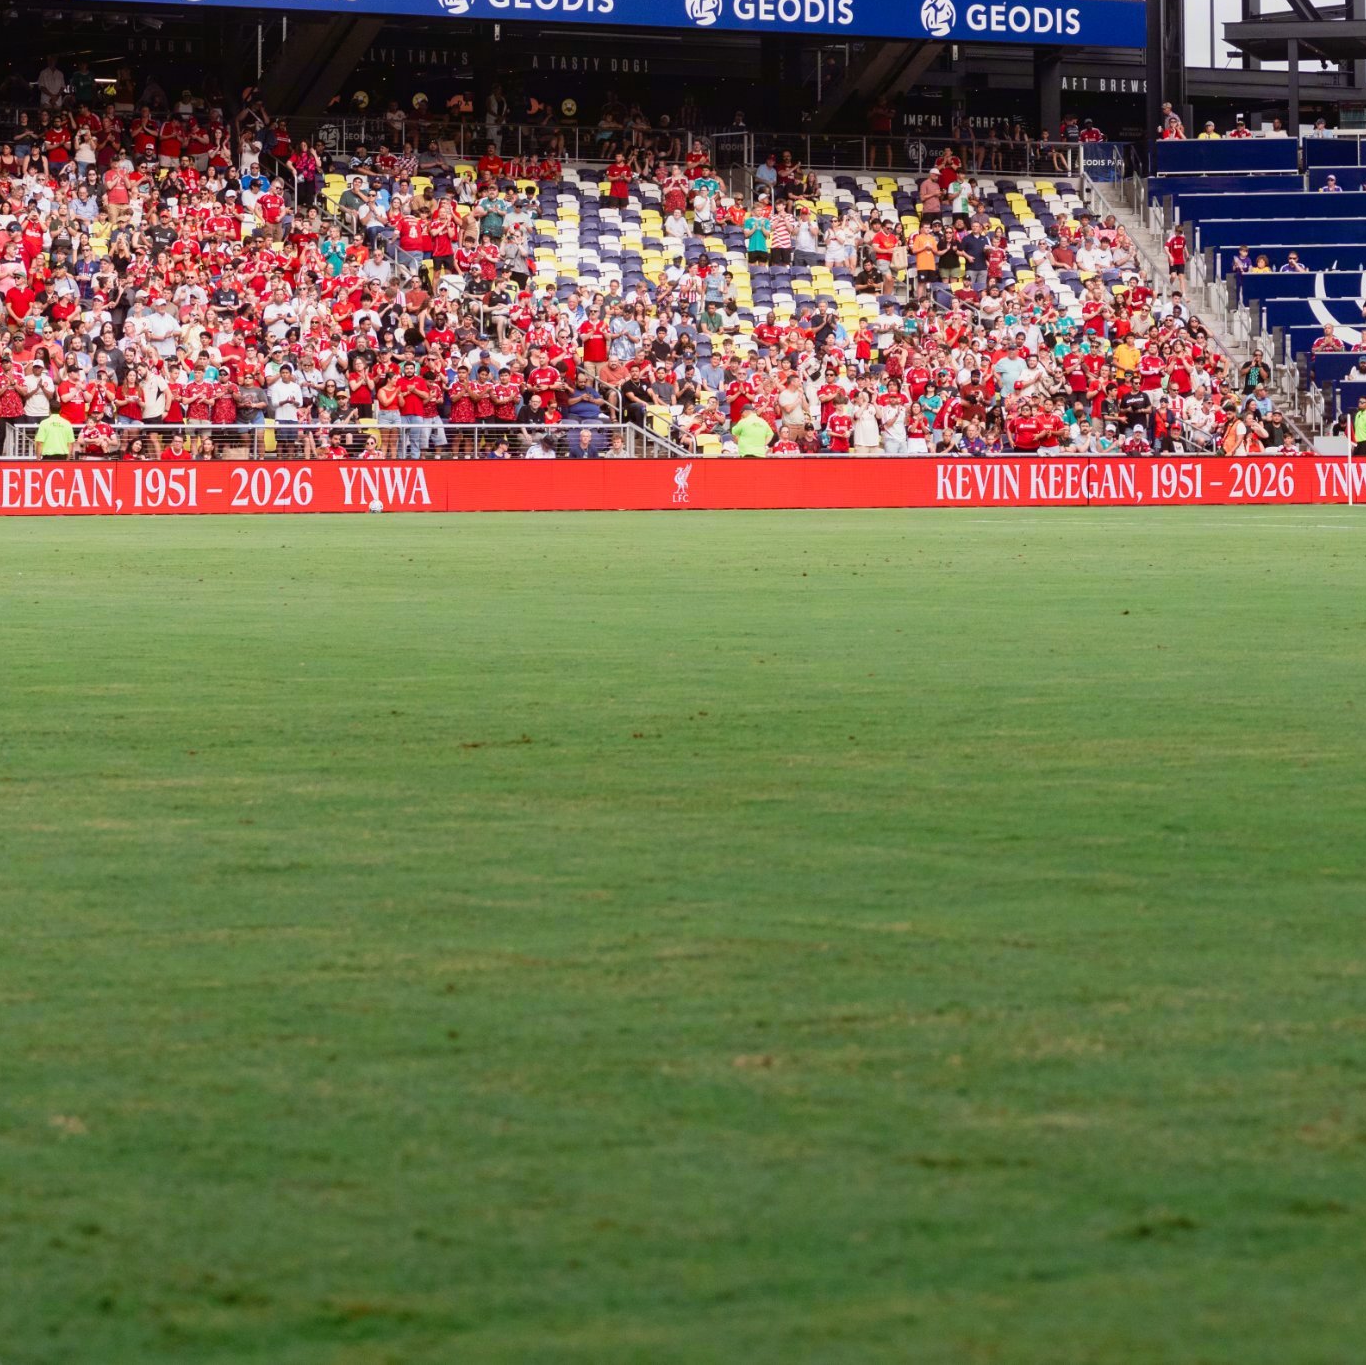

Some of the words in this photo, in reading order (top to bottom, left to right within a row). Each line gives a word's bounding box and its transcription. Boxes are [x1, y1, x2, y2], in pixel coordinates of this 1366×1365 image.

[966, 3, 1081, 35] GEODIS
[550, 55, 601, 71] TASTY
[612, 58, 649, 74] DOG!
[1062, 76, 1087, 91] AFT
[133, 467, 198, 507] 1951
[231, 467, 313, 507] 2026
[339, 467, 432, 505] YNWA
[936, 464, 1020, 500] KEVIN
[1029, 463, 1143, 502] KEEGAN,
[1151, 463, 1202, 499] 1951
[1229, 462, 1295, 498] 2026
